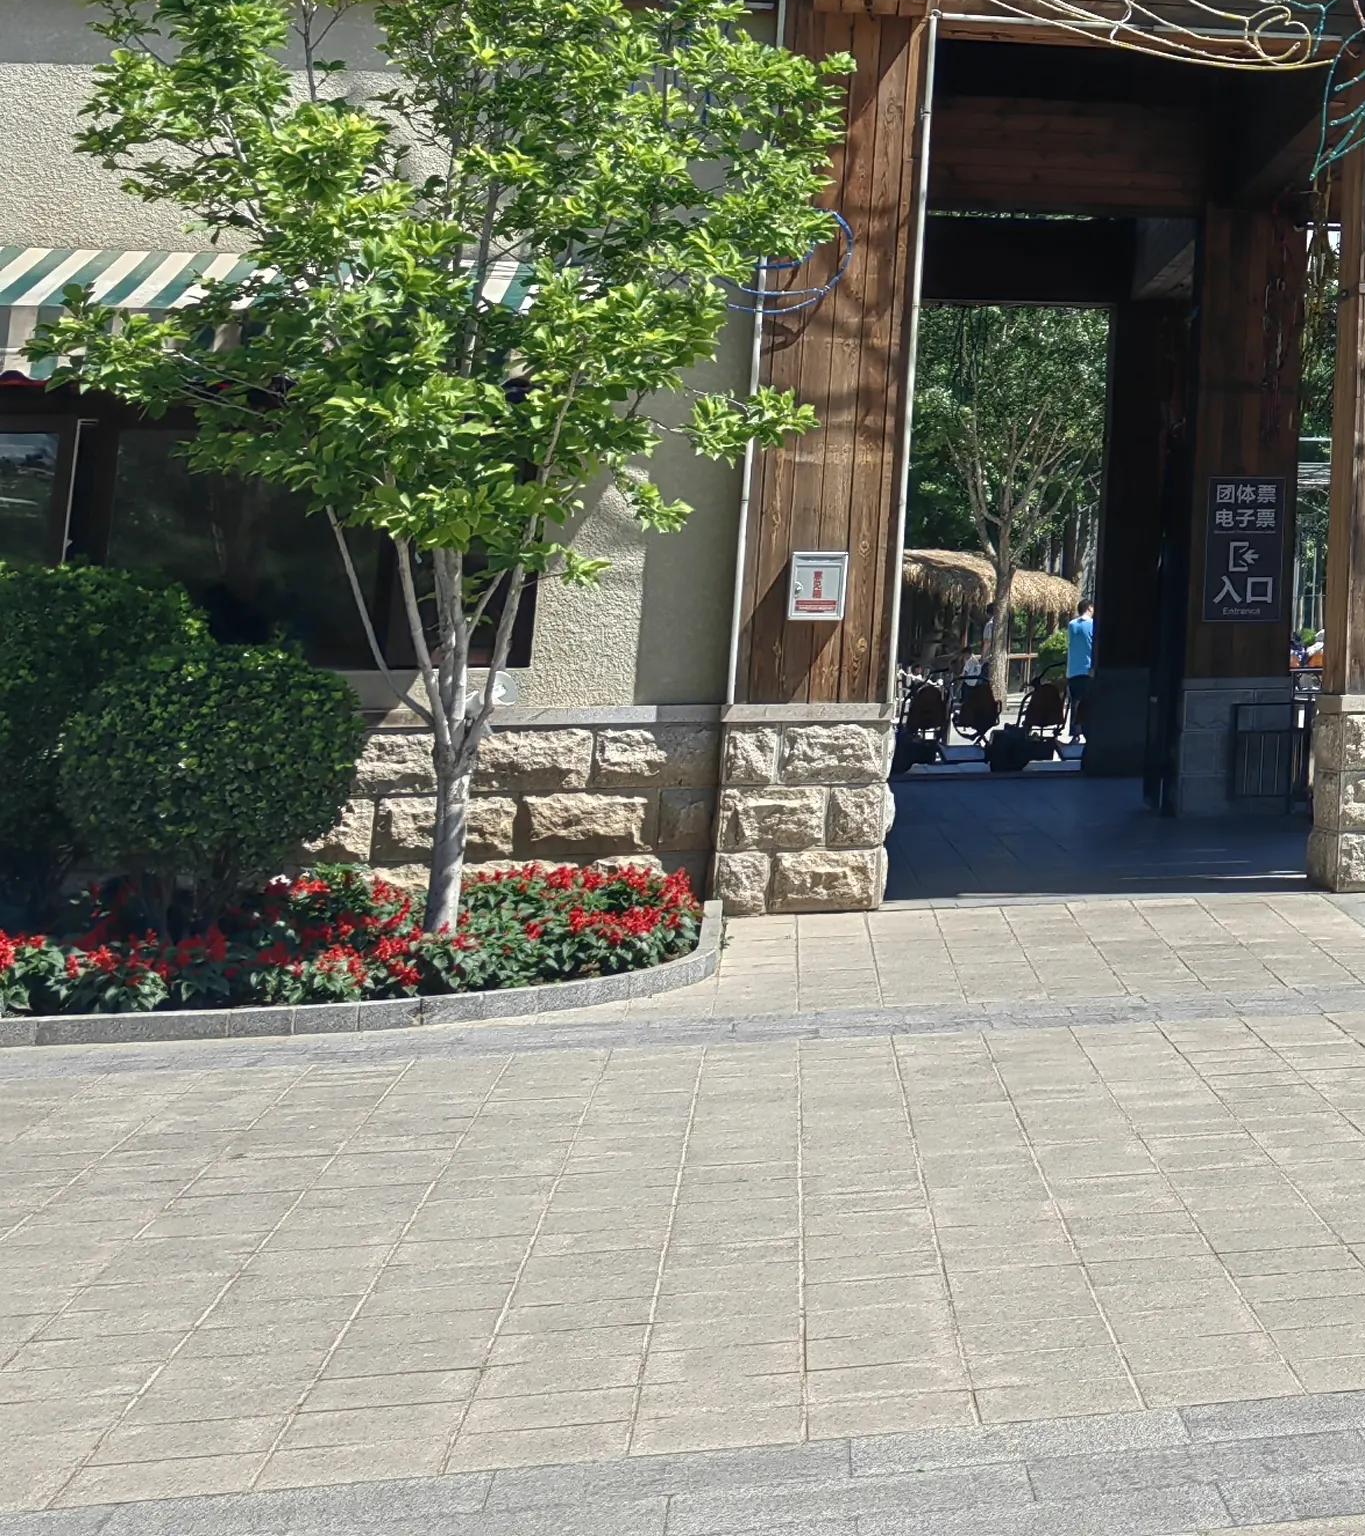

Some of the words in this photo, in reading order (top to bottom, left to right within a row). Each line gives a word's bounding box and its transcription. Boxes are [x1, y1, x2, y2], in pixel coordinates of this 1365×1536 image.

[1215, 483, 1277, 504] 团体票
[1215, 508, 1276, 528] 电子票
[1212, 575, 1274, 604] 入口
